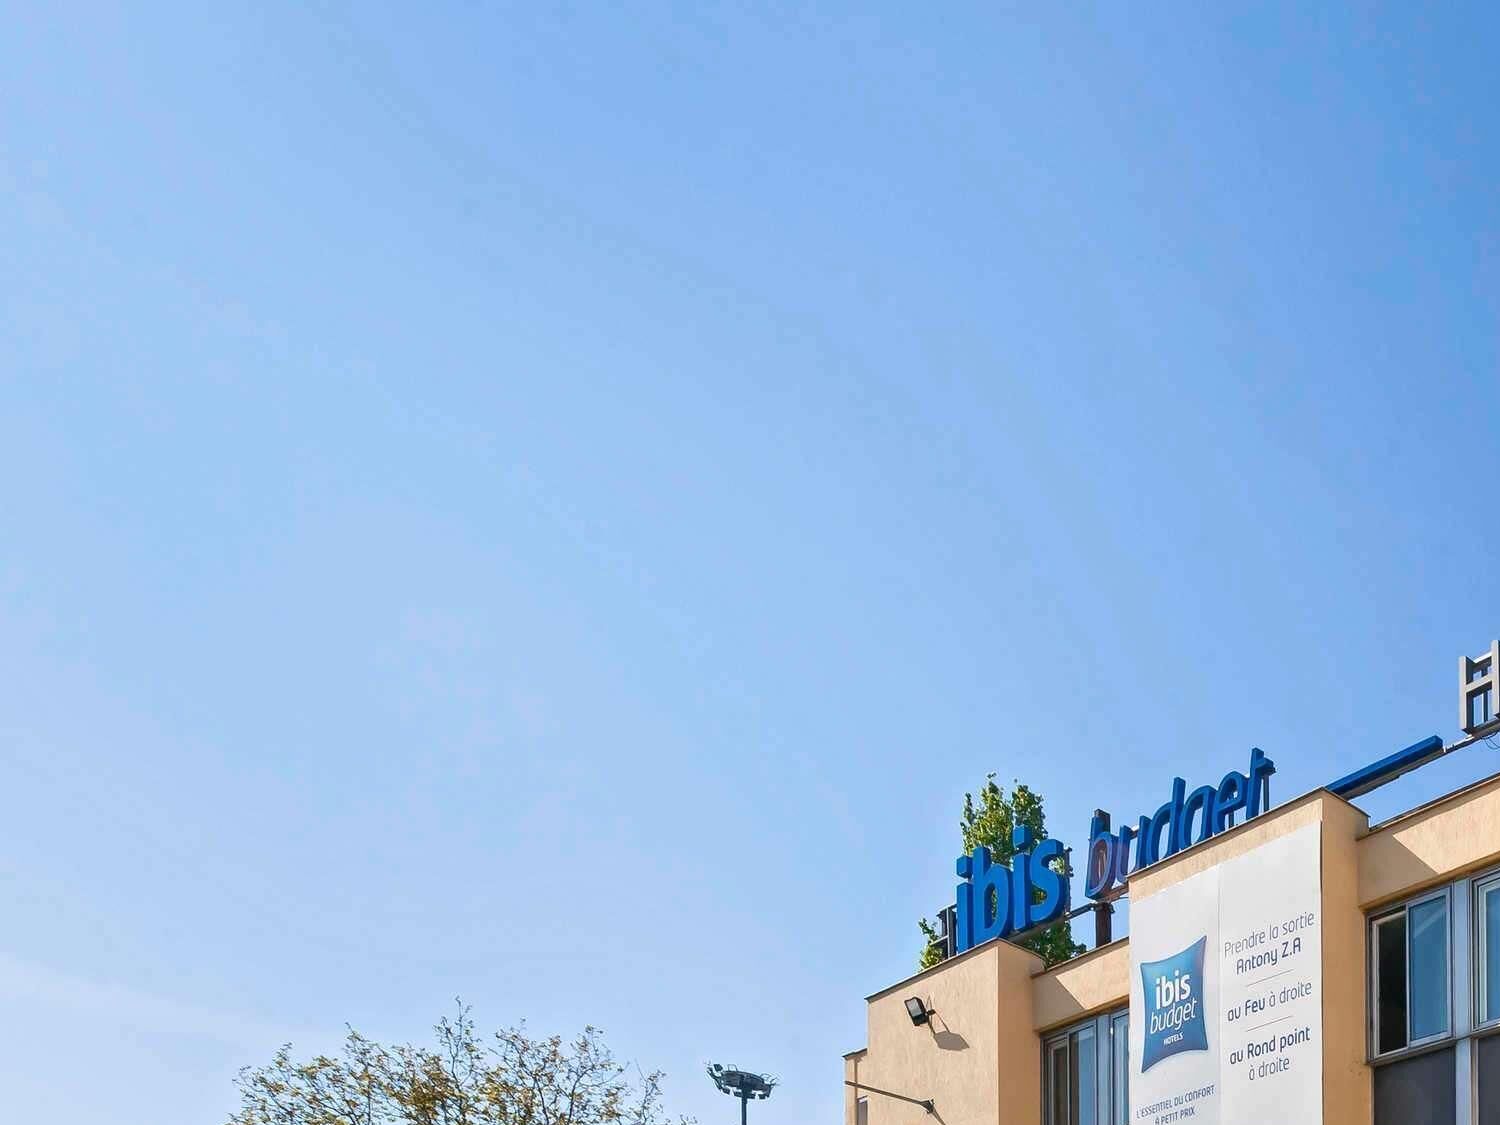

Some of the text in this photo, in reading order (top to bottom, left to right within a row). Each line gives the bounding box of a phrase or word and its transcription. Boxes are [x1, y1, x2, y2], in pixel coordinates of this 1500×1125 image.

[956, 825, 1066, 957] ibis
[1224, 912, 1315, 958] Prendre la sortie
[1236, 937, 1301, 975] Antony Z.A
[1155, 969, 1191, 1010] ibis
[1227, 982, 1312, 1022] au Feu à droite
[1150, 997, 1198, 1035] budget
[1163, 1032, 1184, 1046] HOTELS
[1230, 1027, 1311, 1065] au Rond point
[1249, 1057, 1290, 1081] à droite
[1136, 1085, 1215, 1119] L'ESSENTIEL DU CONFORT
[1161, 1112, 1179, 1125] PETIT
[1180, 1106, 1196, 1119] PRIX
